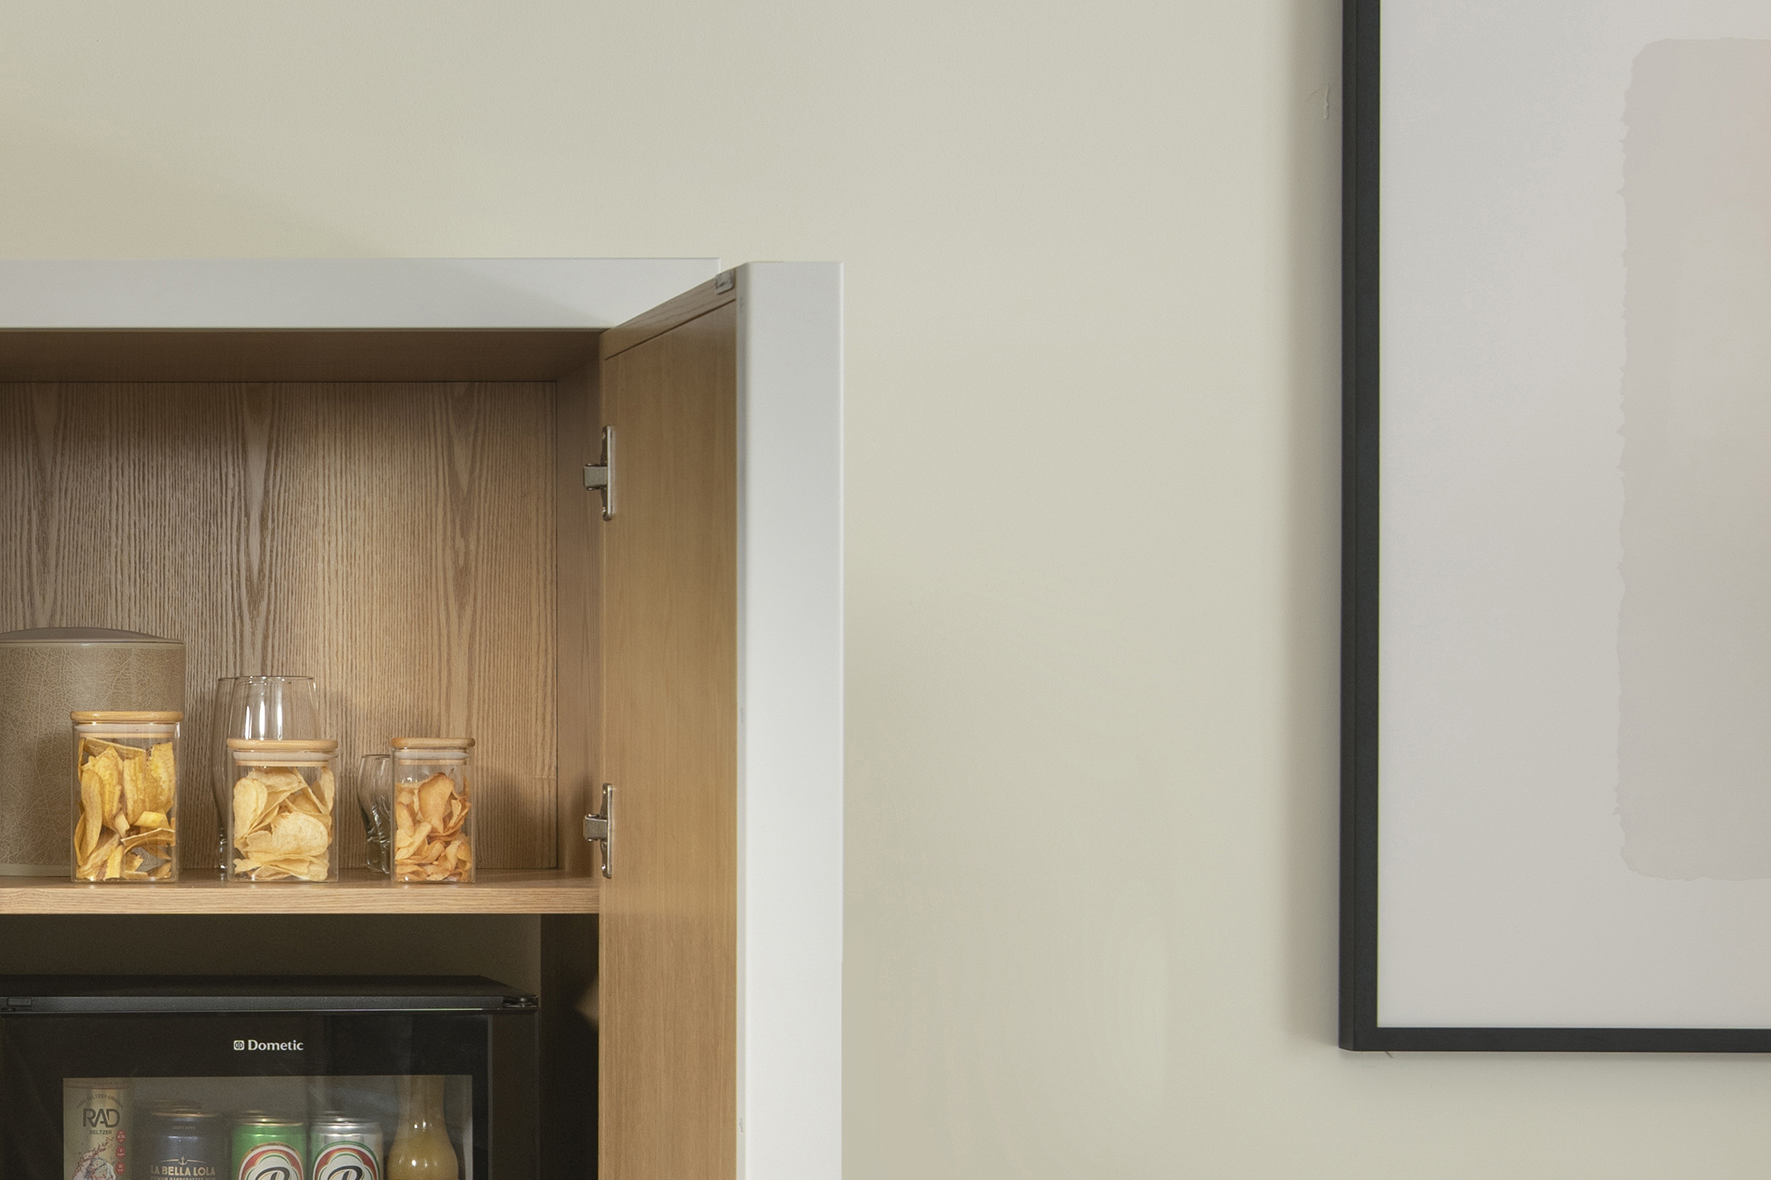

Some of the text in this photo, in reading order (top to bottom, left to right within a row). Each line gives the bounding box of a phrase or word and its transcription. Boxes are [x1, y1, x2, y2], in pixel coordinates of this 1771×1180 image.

[248, 1039, 304, 1051] Dometic
[82, 1107, 121, 1128] RAD
[150, 1164, 216, 1176] LA BELLA LOLA
